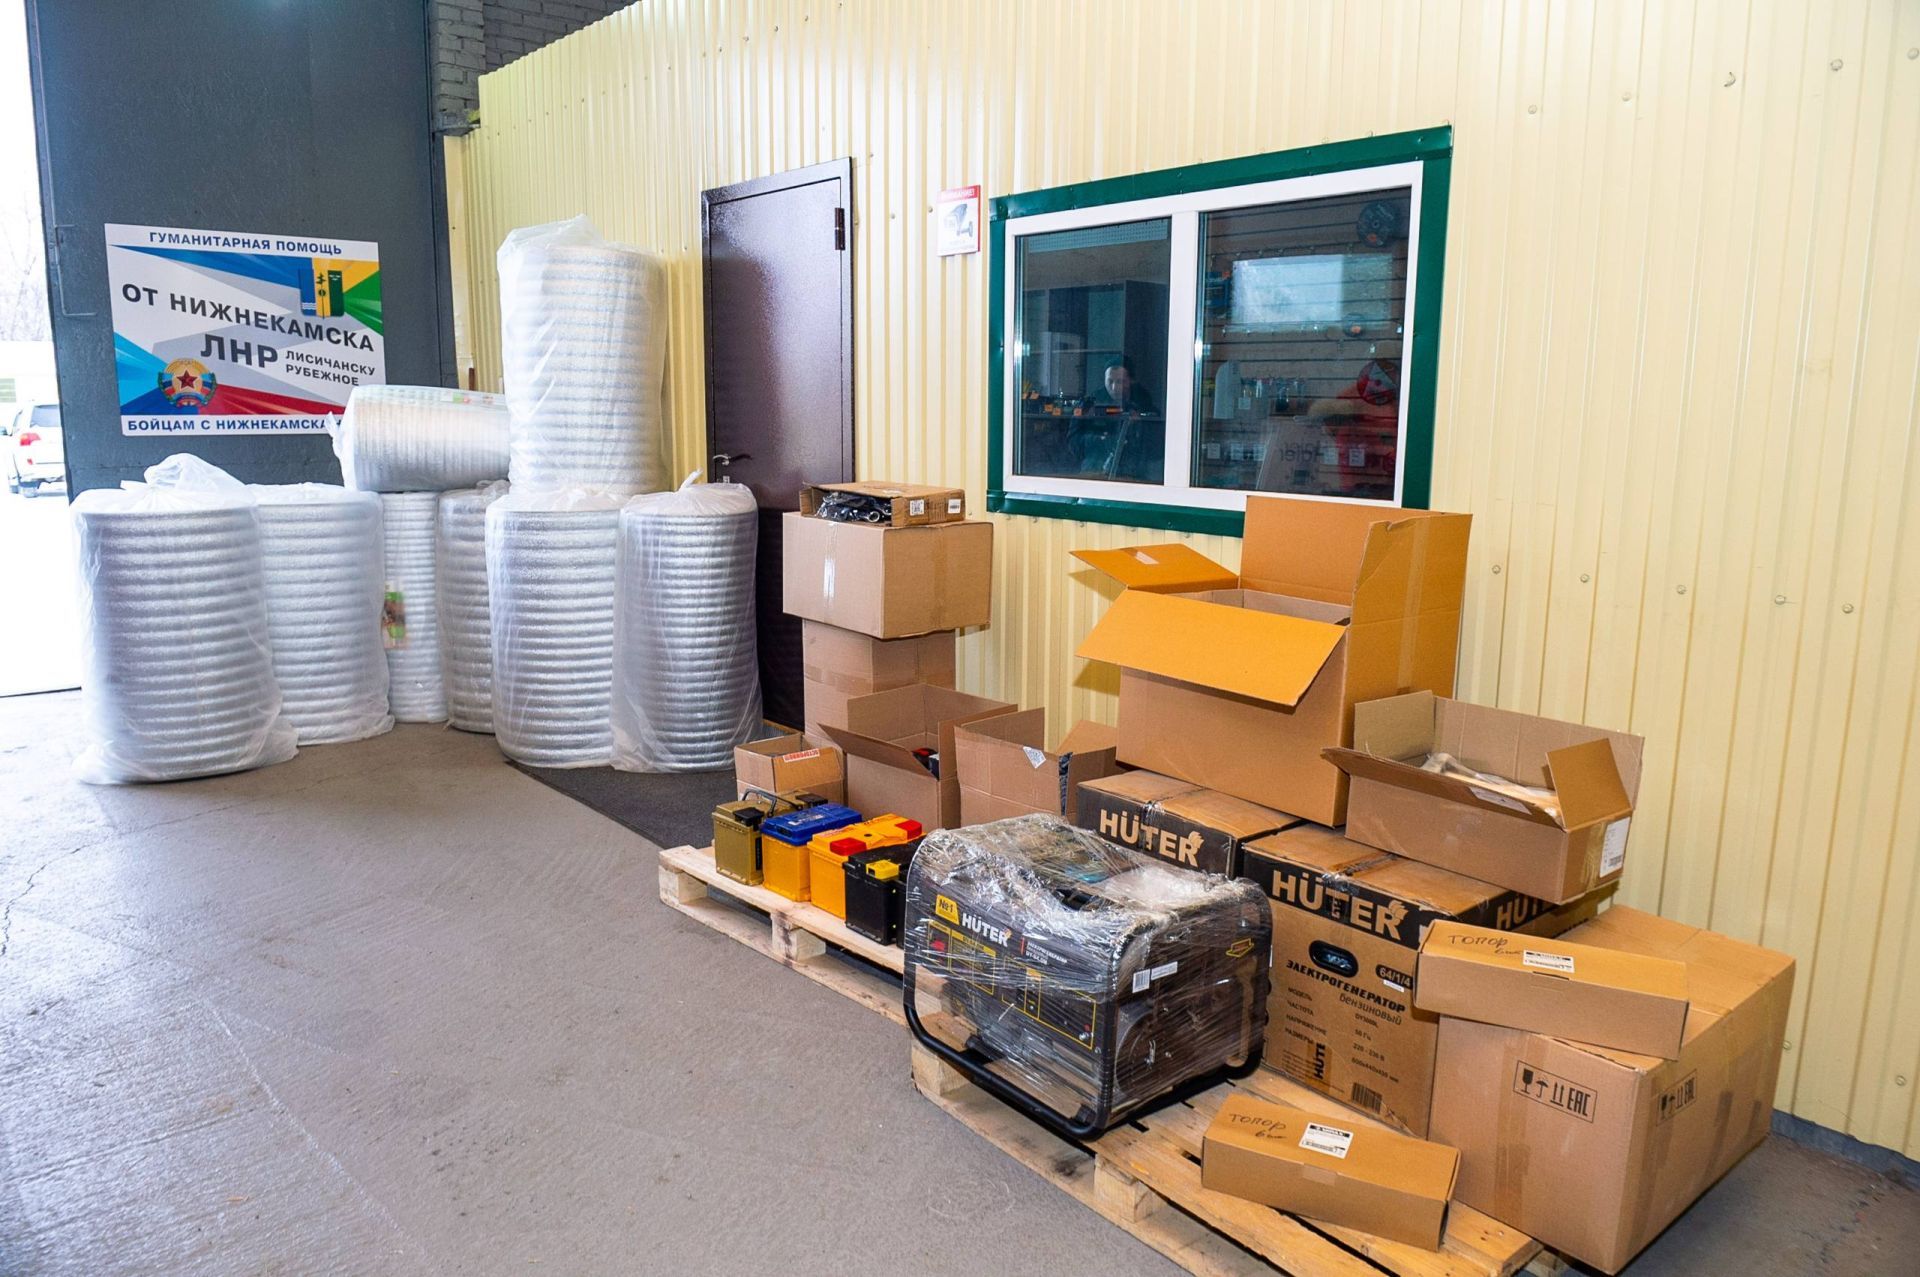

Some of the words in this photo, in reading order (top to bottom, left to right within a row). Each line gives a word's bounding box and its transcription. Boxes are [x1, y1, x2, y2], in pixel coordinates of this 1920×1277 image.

[150, 232, 270, 250] ГУМАНИТАРНАЯ
[276, 241, 342, 256] ПОМОЩЬ
[122, 283, 158, 306] ОТ
[170, 292, 375, 352] НИЖНЕКАМСКА
[200, 334, 278, 369] ЛНР
[285, 350, 376, 377] ЛИСИЧАНСКУ
[285, 363, 360, 387] РУБЕЖНОЕ
[128, 418, 195, 432] БОЙЦАМ
[200, 419, 210, 431] С
[1100, 808, 1201, 867] HÜTER
[1272, 869, 1403, 940] HÜTER
[961, 912, 1010, 947] HÜTER
[1286, 959, 1406, 1013] ЭЛЕКТРОГЕНЕРАТОР
[1287, 1000, 1314, 1016] ЧАСТОТА
[1285, 1027, 1314, 1044] РАЗМЕРЫ
[1286, 1014, 1328, 1036] НАПРЯЖЕНИЕ
[1567, 1087, 1592, 1117] EAC
